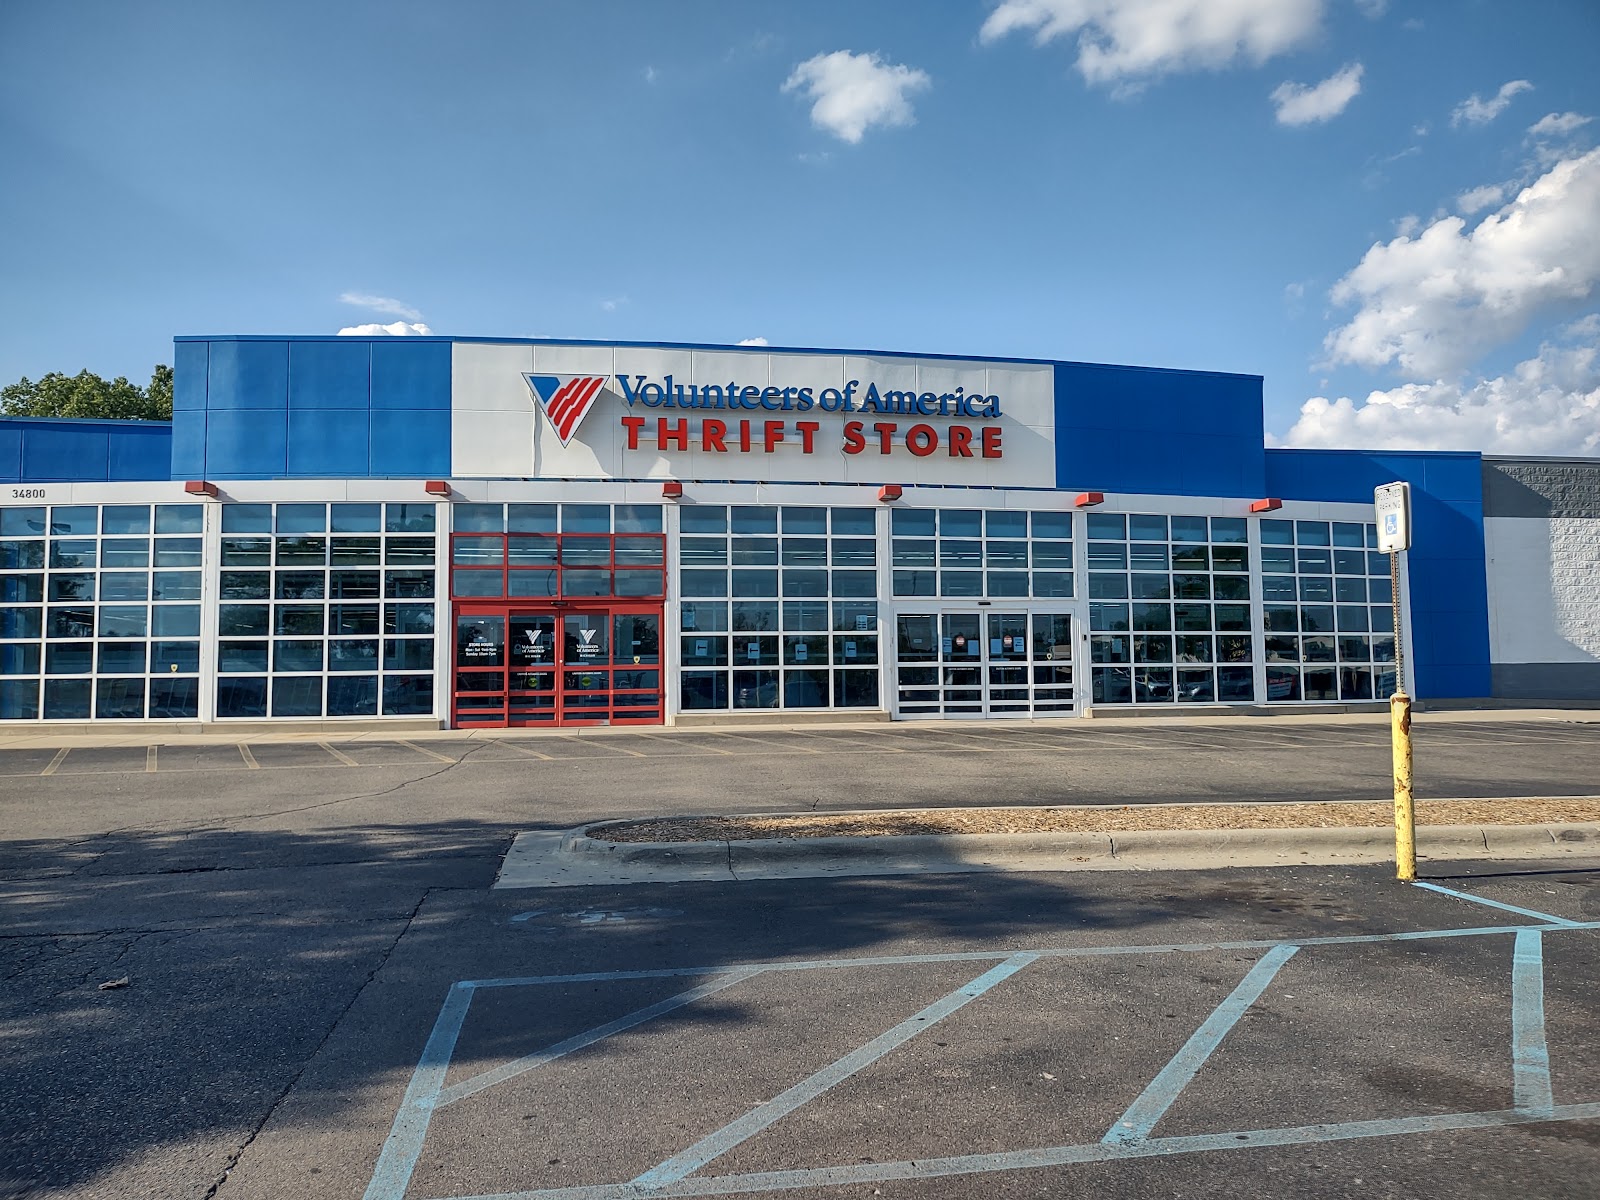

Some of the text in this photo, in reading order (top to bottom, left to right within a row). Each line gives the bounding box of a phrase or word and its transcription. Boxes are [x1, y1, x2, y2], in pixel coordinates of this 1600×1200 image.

[615, 374, 1003, 418] Volunteers of America
[621, 416, 1002, 458] THRIFT STORE
[12, 489, 46, 499] 34800
